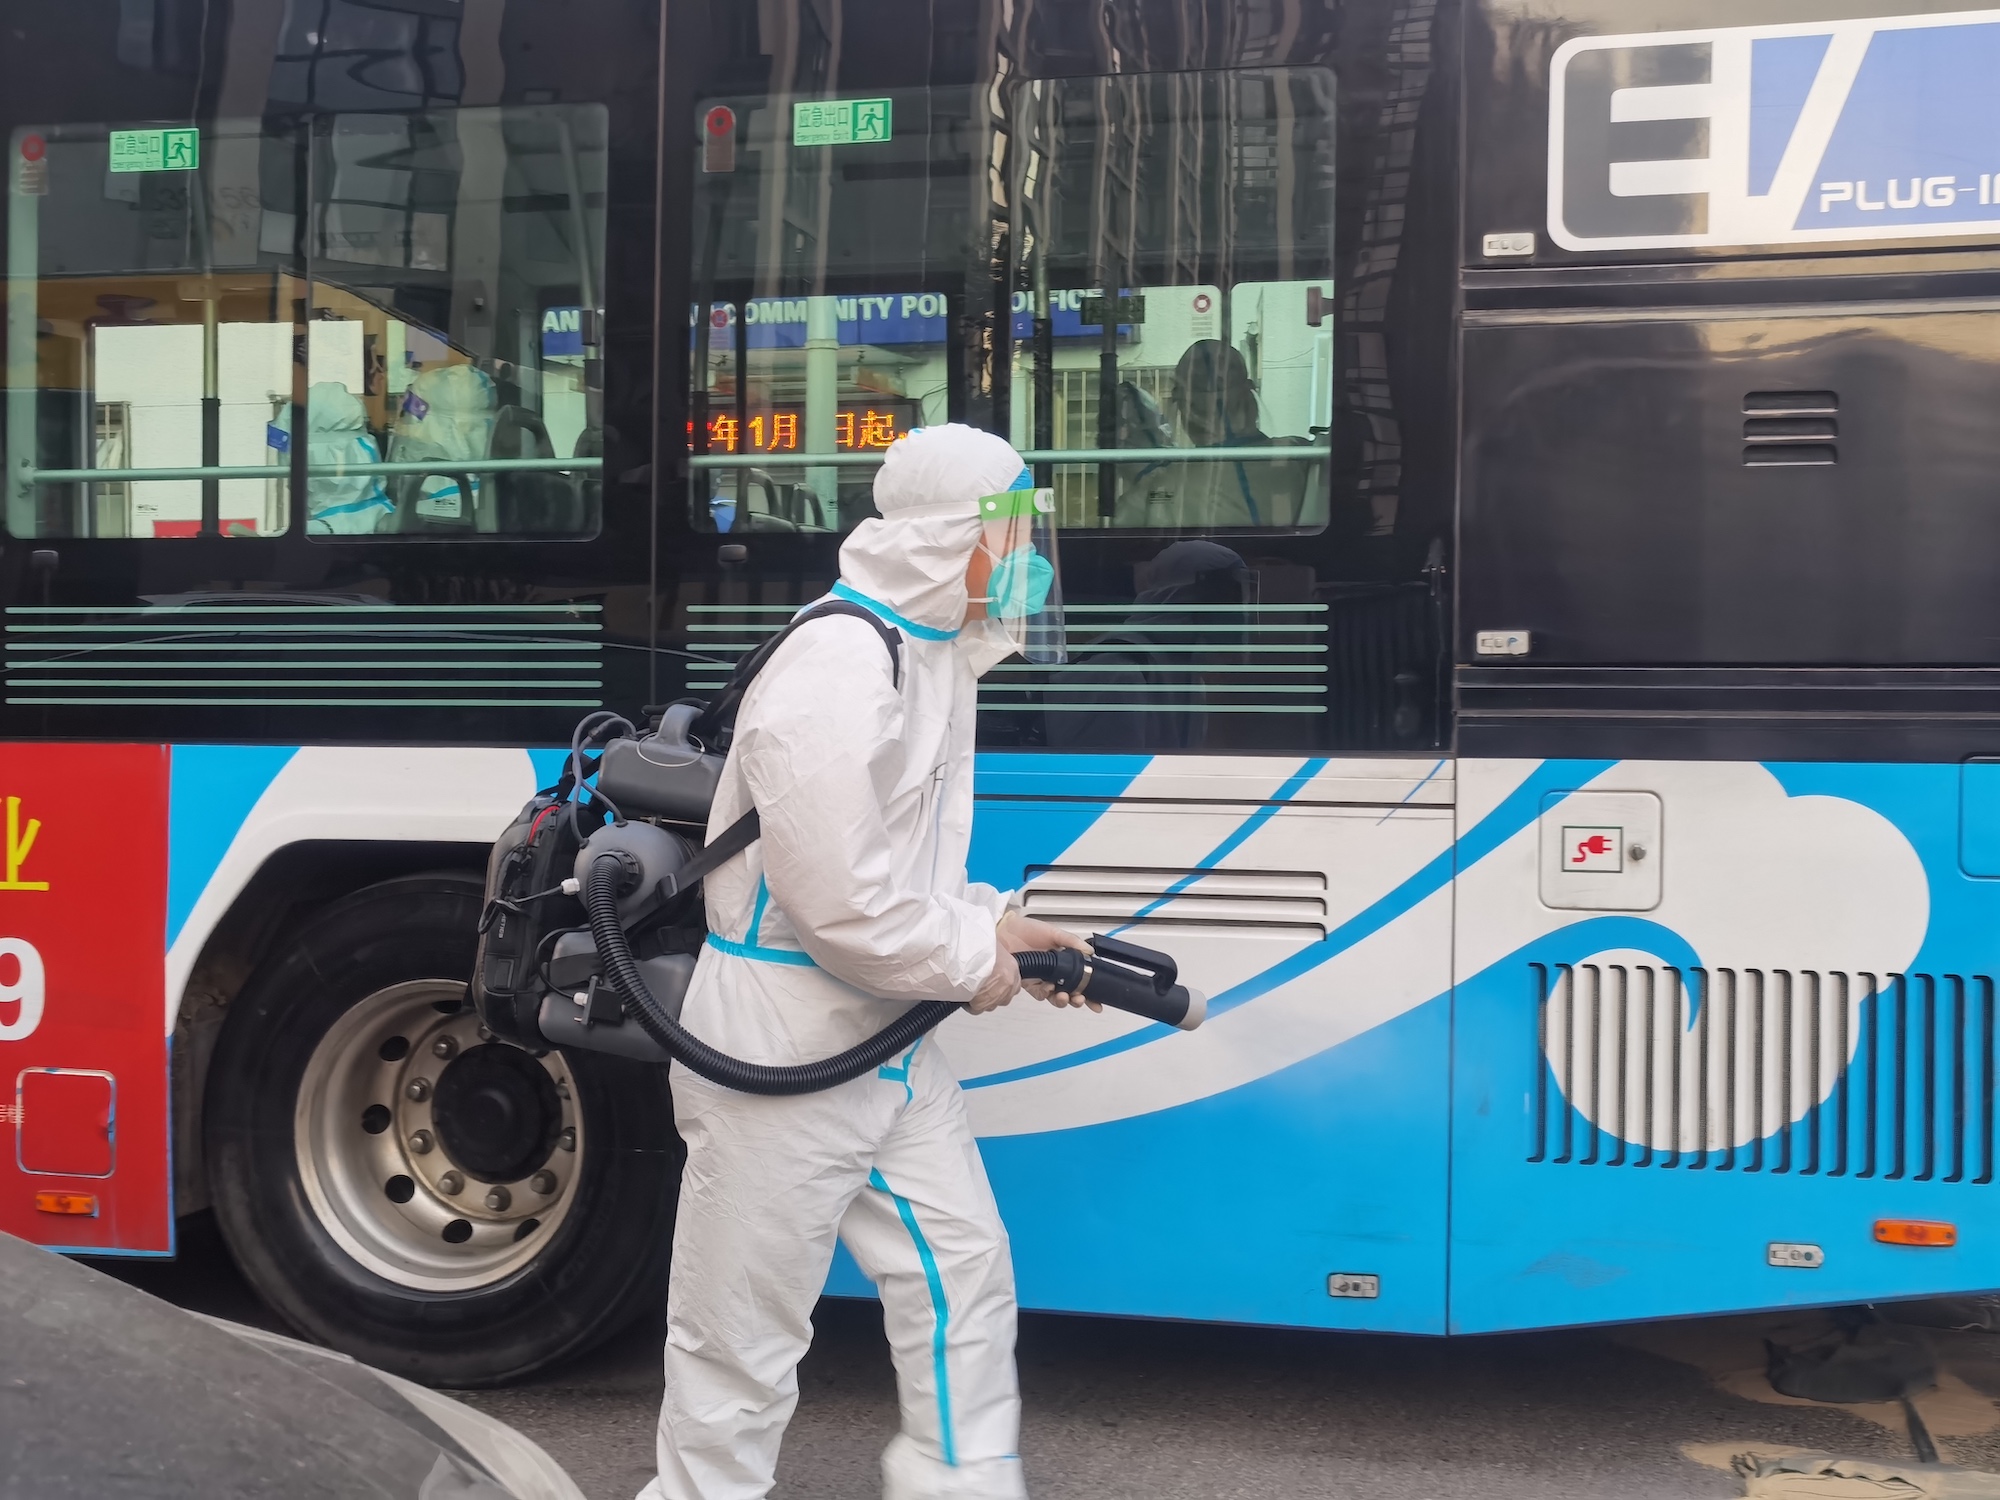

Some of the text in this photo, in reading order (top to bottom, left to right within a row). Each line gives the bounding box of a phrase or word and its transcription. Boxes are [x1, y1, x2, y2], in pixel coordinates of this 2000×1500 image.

[798, 105, 848, 128] 应急出口
[114, 135, 160, 155] 应急出口
[1562, 34, 1876, 239] EV
[1820, 172, 2000, 212] PLUG-I
